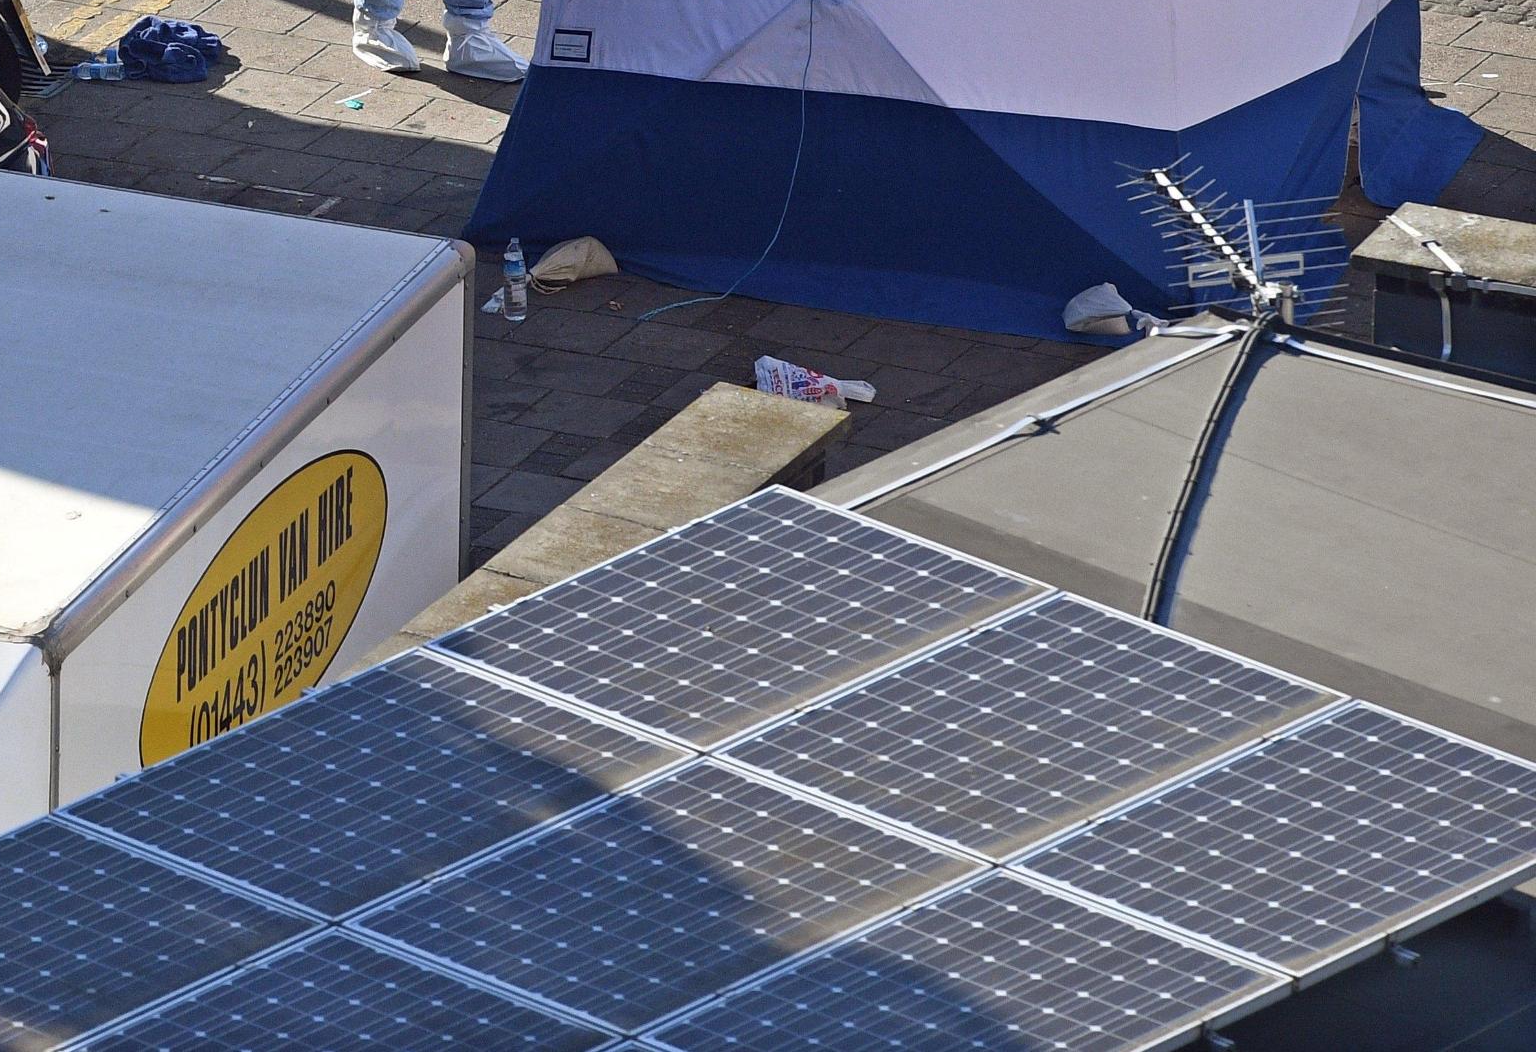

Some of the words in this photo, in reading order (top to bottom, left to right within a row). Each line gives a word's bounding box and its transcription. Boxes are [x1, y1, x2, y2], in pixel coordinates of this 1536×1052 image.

[176, 545, 270, 704] PONTYCLUN
[279, 508, 309, 603] VAN
[318, 465, 354, 568] HIRE
[274, 579, 336, 659] 223890
[273, 614, 334, 699] 223907
